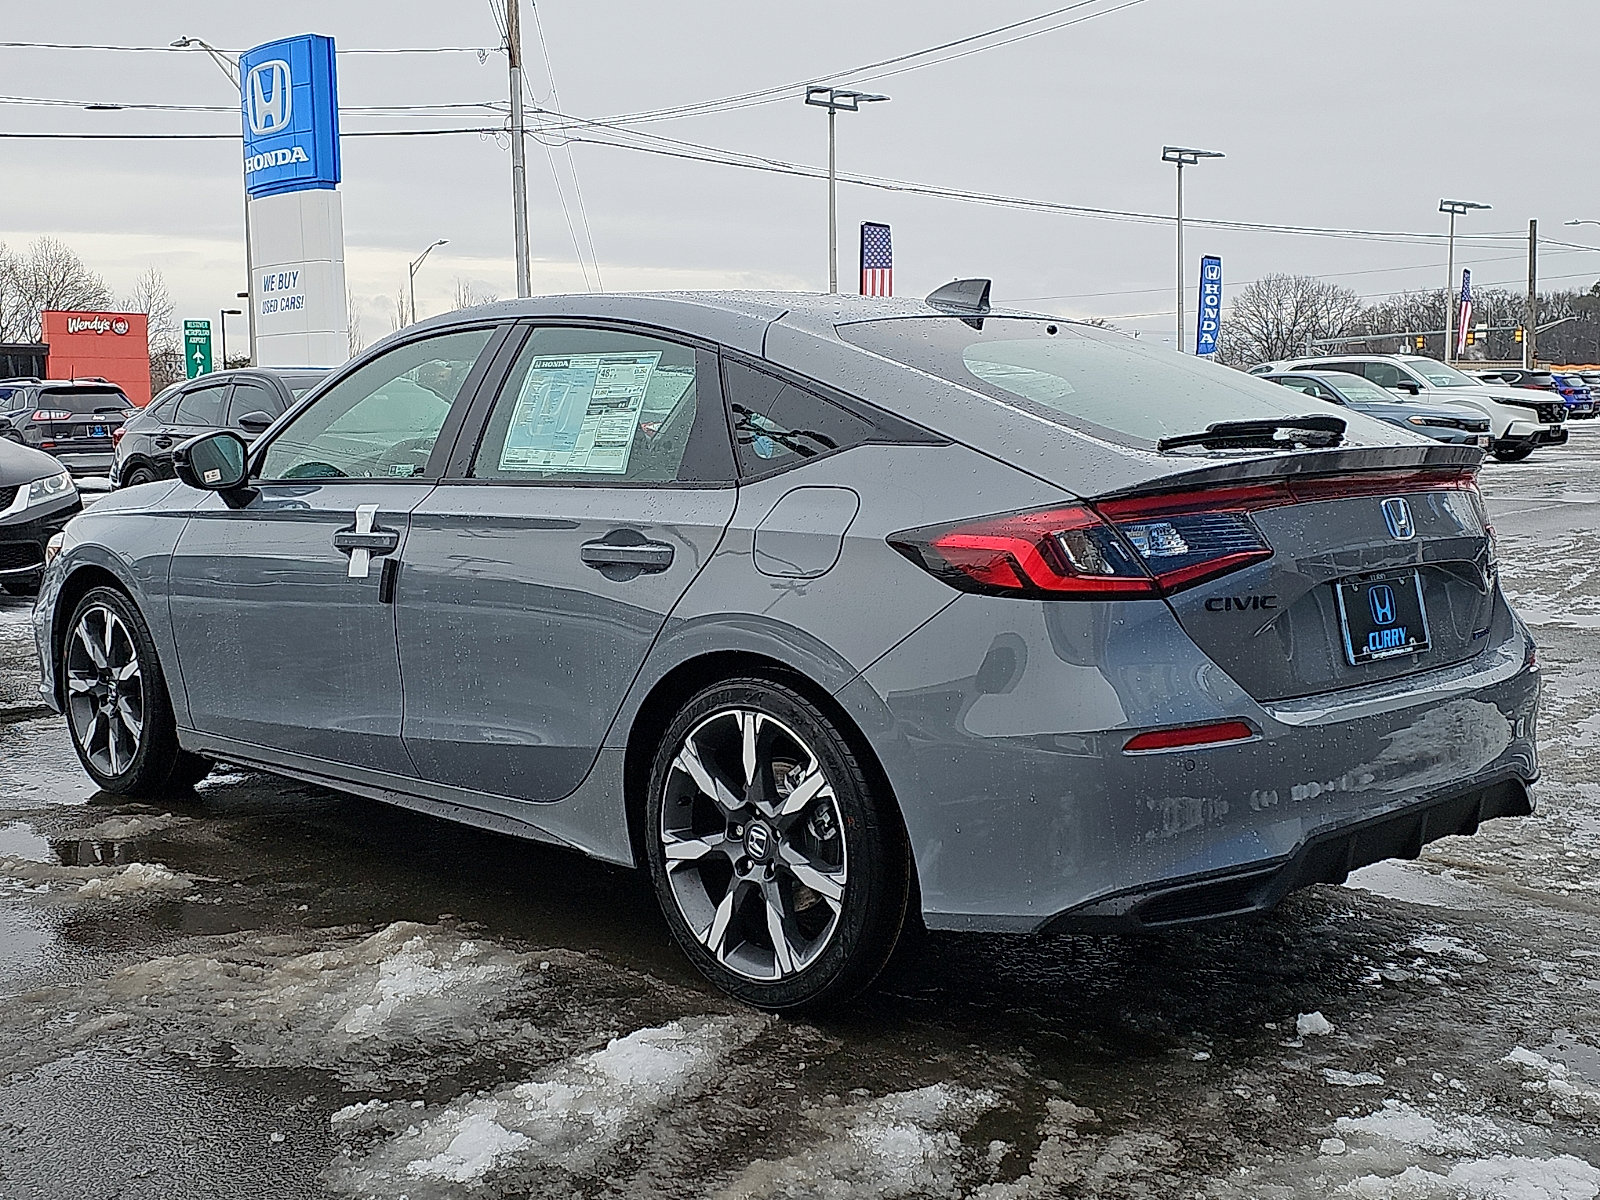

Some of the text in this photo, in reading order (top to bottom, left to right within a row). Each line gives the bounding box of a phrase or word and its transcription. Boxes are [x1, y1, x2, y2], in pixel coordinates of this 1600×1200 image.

[245, 147, 309, 174] HONDA
[263, 270, 299, 292] WE BUY
[262, 295, 304, 314] USED CARS!
[1200, 284, 1219, 344] HONDA
[67, 315, 111, 334] Wendy's
[541, 360, 569, 368] HONDA
[1204, 595, 1278, 612] CIVIC
[1368, 626, 1407, 651] CURRY
